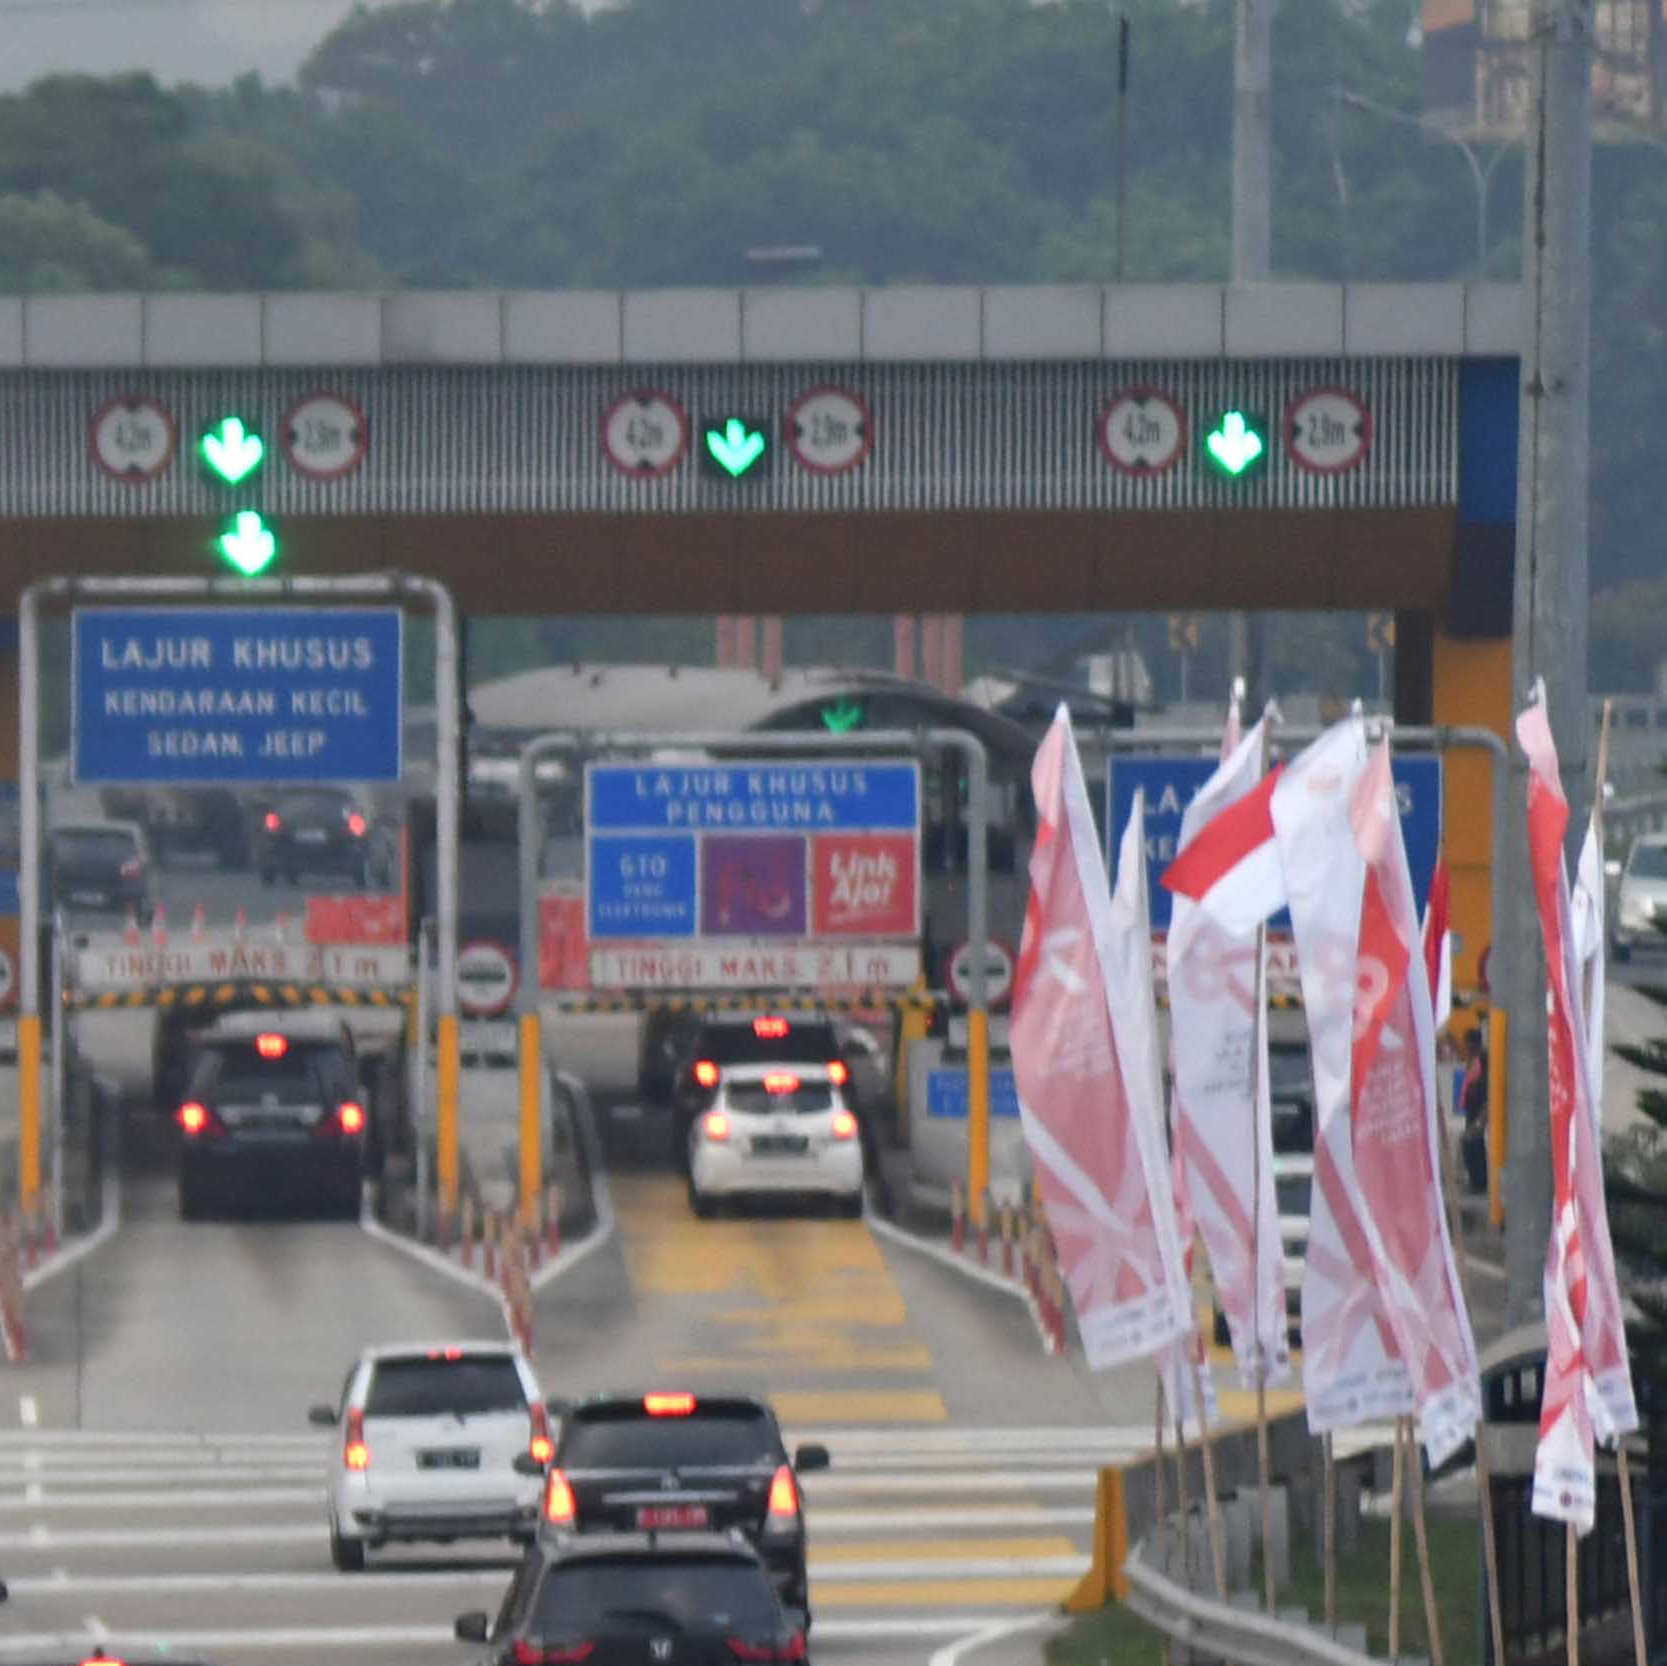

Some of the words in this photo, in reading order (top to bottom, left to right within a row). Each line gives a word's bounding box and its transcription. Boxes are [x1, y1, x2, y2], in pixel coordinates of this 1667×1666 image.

[101, 637, 211, 671] LAJUR
[233, 636, 373, 670] KHUSUS
[104, 690, 274, 717] KENDARAAN
[291, 690, 369, 716] KECIL
[257, 732, 327, 758] JEEP
[635, 773, 737, 798] LAJUR
[749, 772, 868, 797] KHUSUS
[667, 800, 835, 824] PENGGUNA
[617, 952, 701, 978] TINGGI
